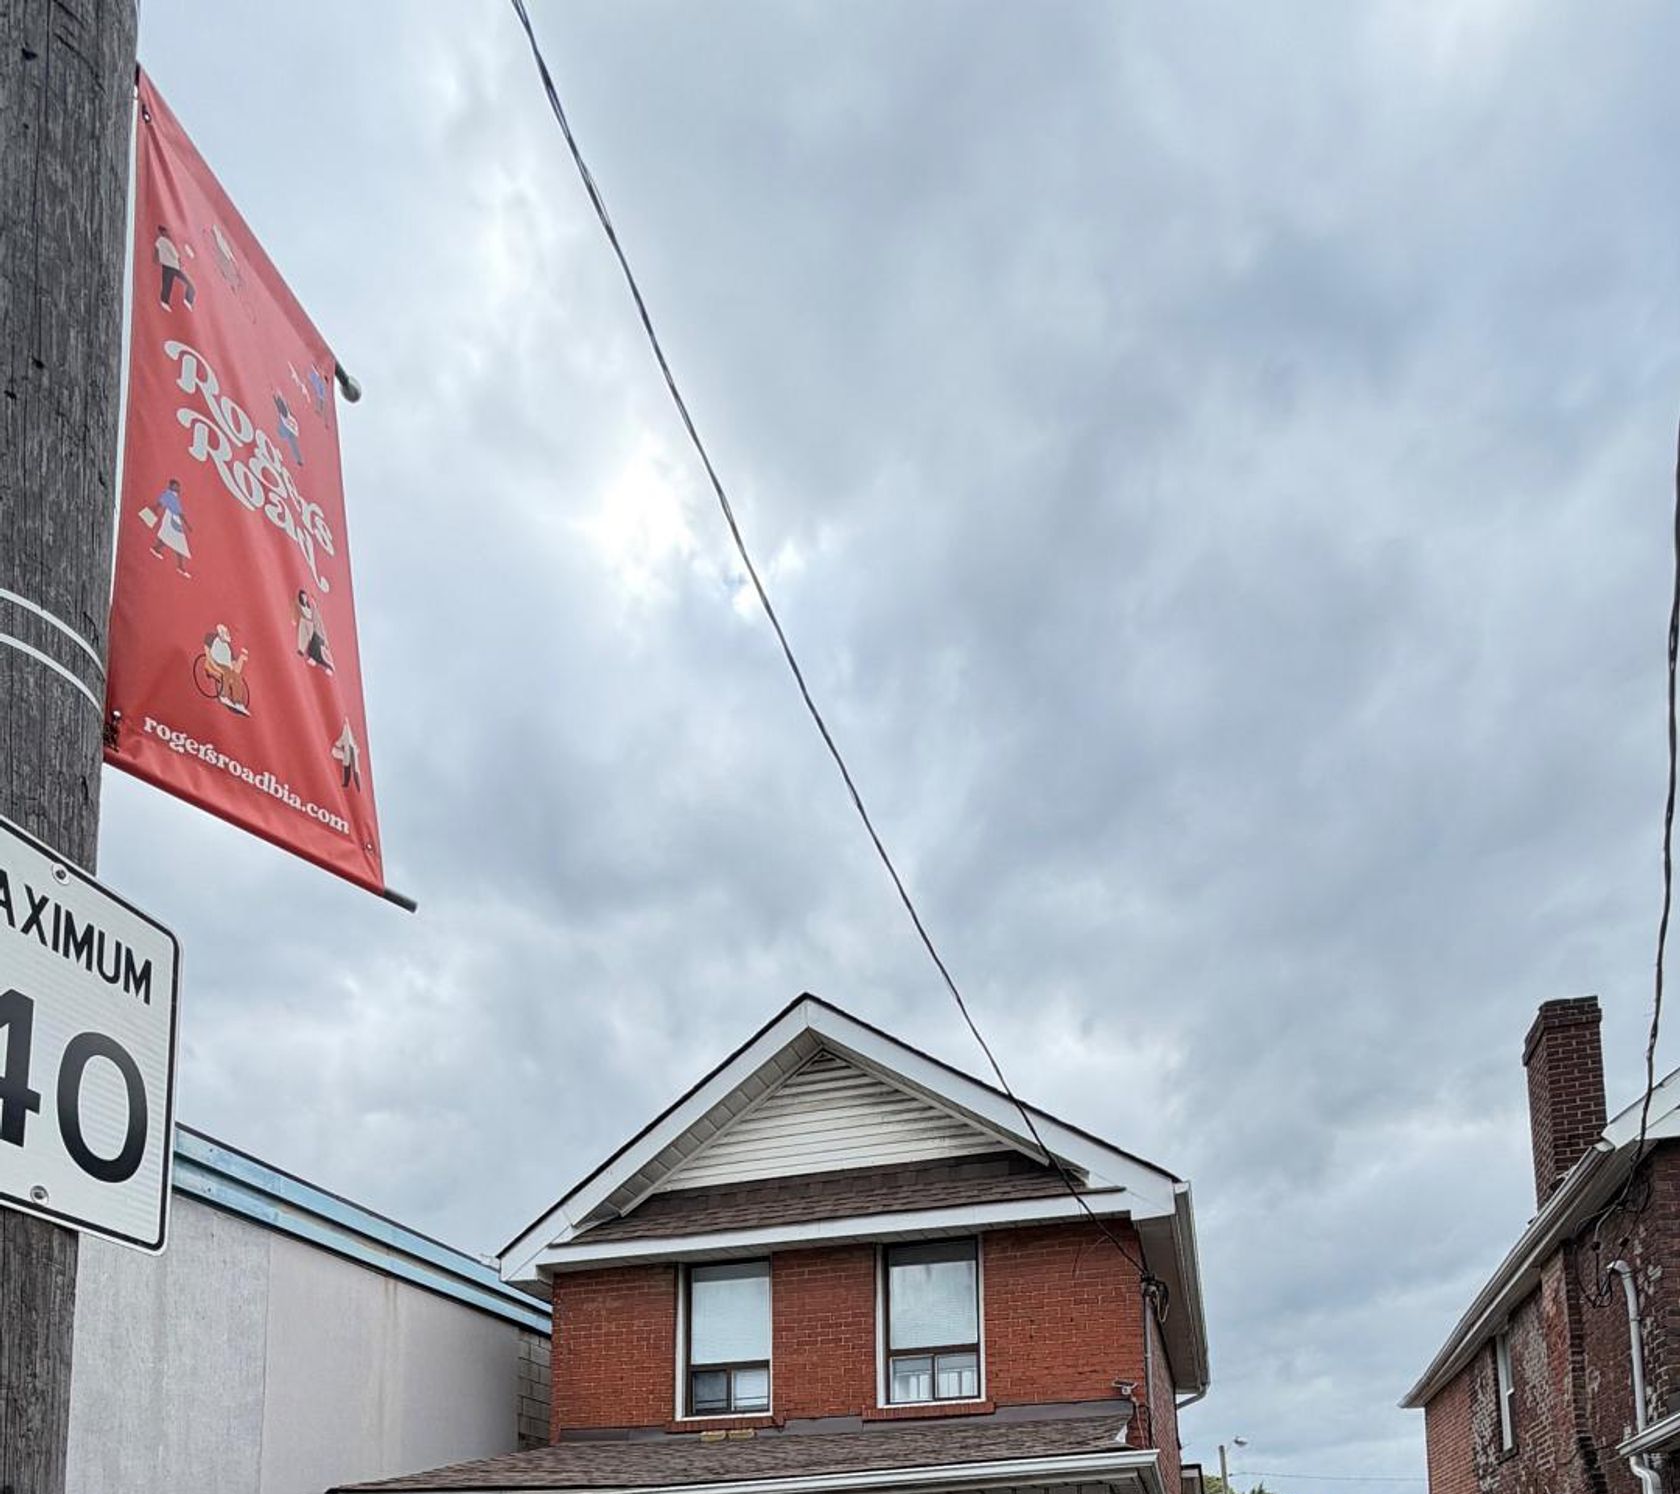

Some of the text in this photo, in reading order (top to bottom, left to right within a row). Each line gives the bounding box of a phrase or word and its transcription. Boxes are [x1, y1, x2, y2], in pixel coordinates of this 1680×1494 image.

[164, 340, 335, 556] Rogers
[176, 408, 331, 593] Road
[144, 716, 350, 835] rogersroadbia.com
[0, 866, 152, 1006] AXIMUM
